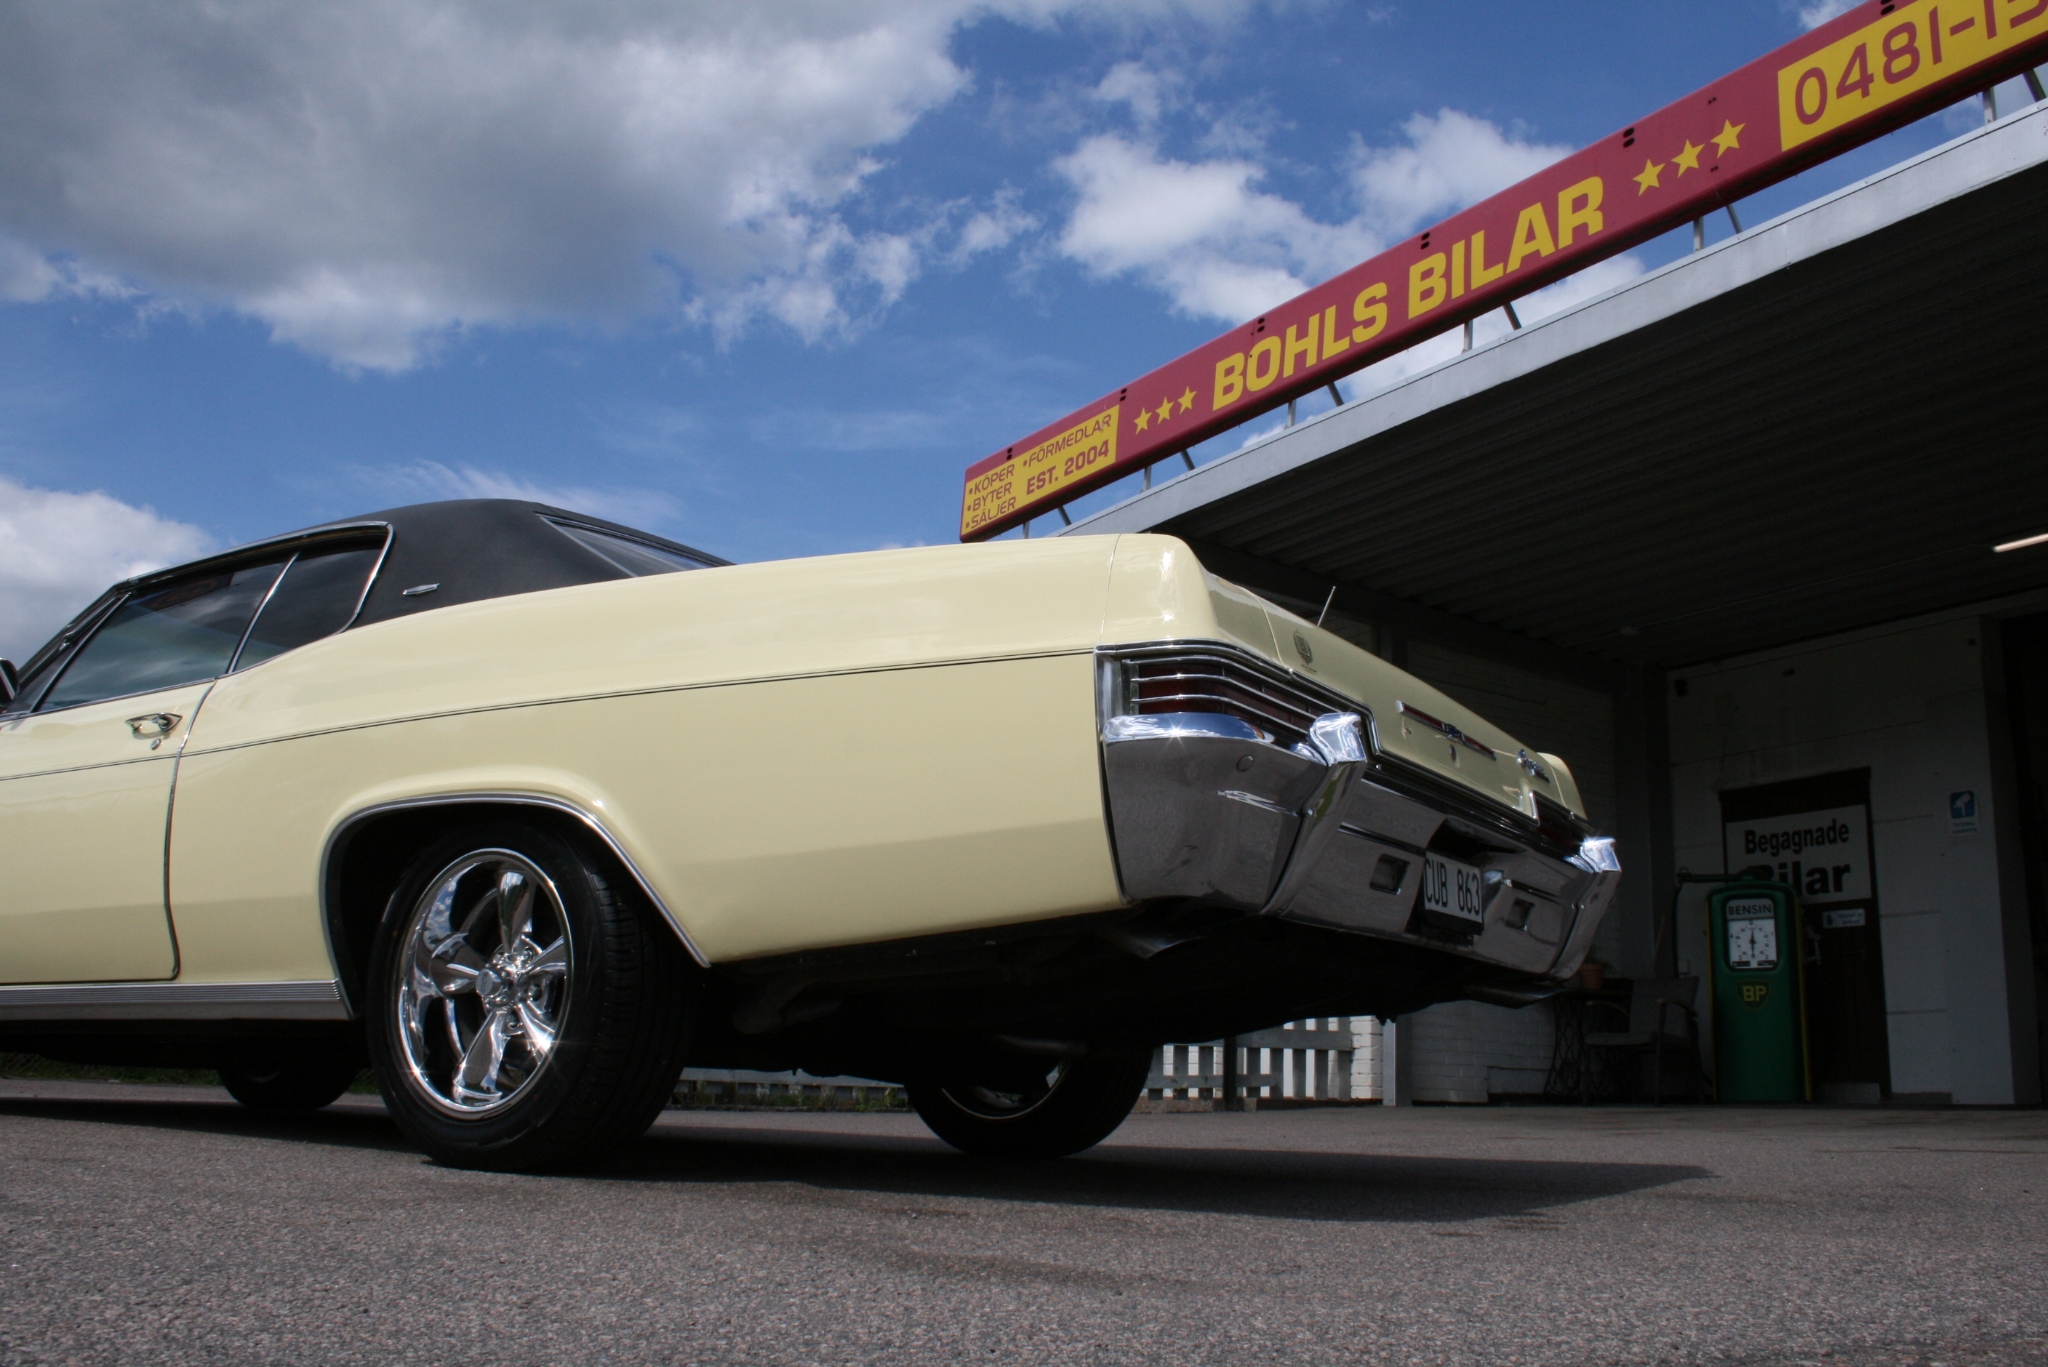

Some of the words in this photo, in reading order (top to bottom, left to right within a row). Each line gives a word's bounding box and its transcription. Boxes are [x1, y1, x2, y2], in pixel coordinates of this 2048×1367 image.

[1213, 282, 1388, 412] BOHLS
[1408, 176, 1604, 320] BILAR
[974, 463, 1015, 495] KÖPER
[1028, 414, 1111, 467] FÖRMEDLAR
[1026, 465, 1059, 495] EST.
[1064, 439, 1110, 477] 2004
[971, 496, 1017, 529] SÄLJER
[972, 482, 1013, 512] BYTER
[1744, 818, 1850, 857] Begagnade
[1424, 857, 1448, 908] CUB
[1457, 867, 1480, 916] 863
[1728, 904, 1771, 915] BENSIN
[1742, 985, 1767, 1002] BP
